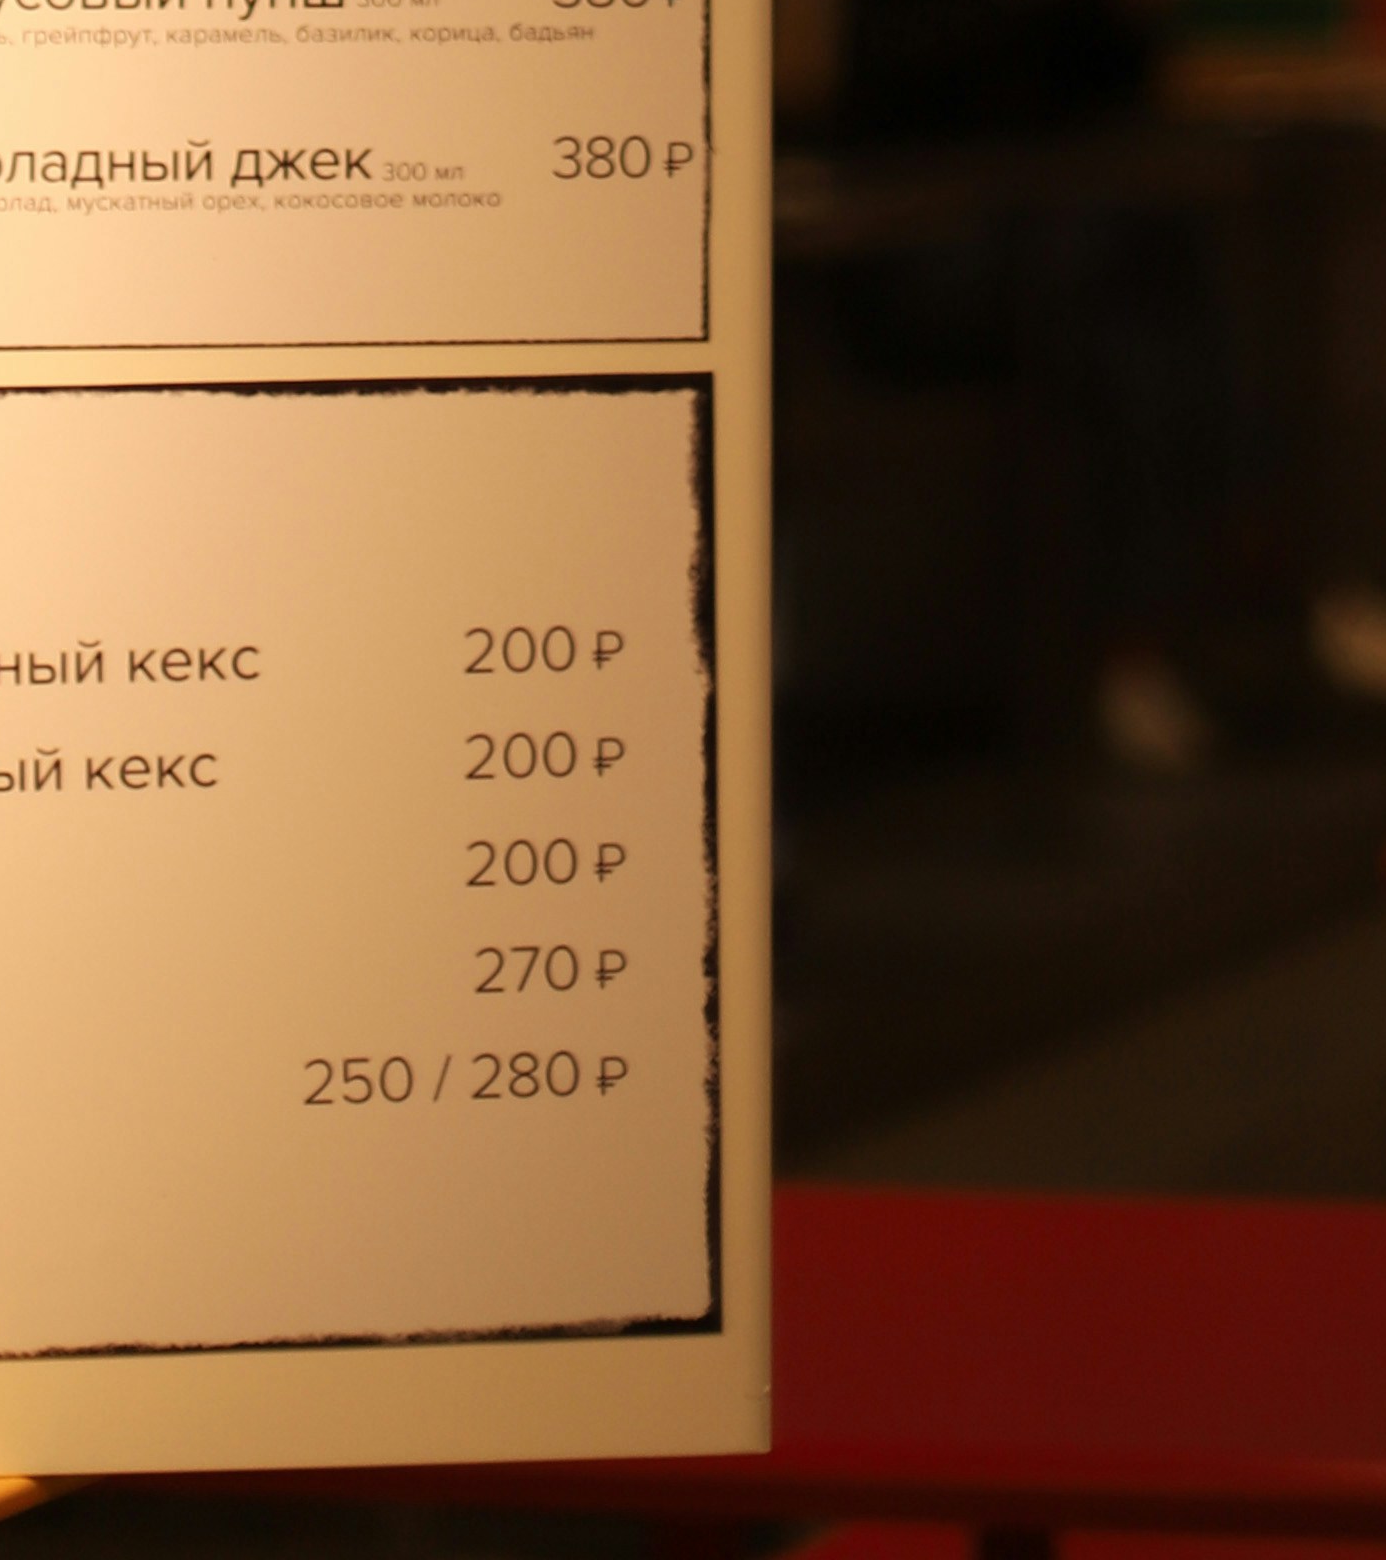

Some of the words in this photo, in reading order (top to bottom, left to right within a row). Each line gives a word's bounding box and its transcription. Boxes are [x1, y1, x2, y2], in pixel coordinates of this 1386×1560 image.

[165, 26, 289, 49] карамель,
[409, 24, 502, 46] корица,
[508, 21, 595, 43] бадьян
[229, 147, 372, 189] джек
[381, 160, 429, 183] 300
[434, 165, 465, 181] мл
[67, 191, 195, 217] мускатный
[201, 193, 266, 214] орех,
[273, 192, 405, 210] кокосовое
[411, 191, 504, 209] молоко
[128, 645, 260, 683] кекс
[86, 752, 218, 790] кекс
[303, 1055, 414, 1106] 250
